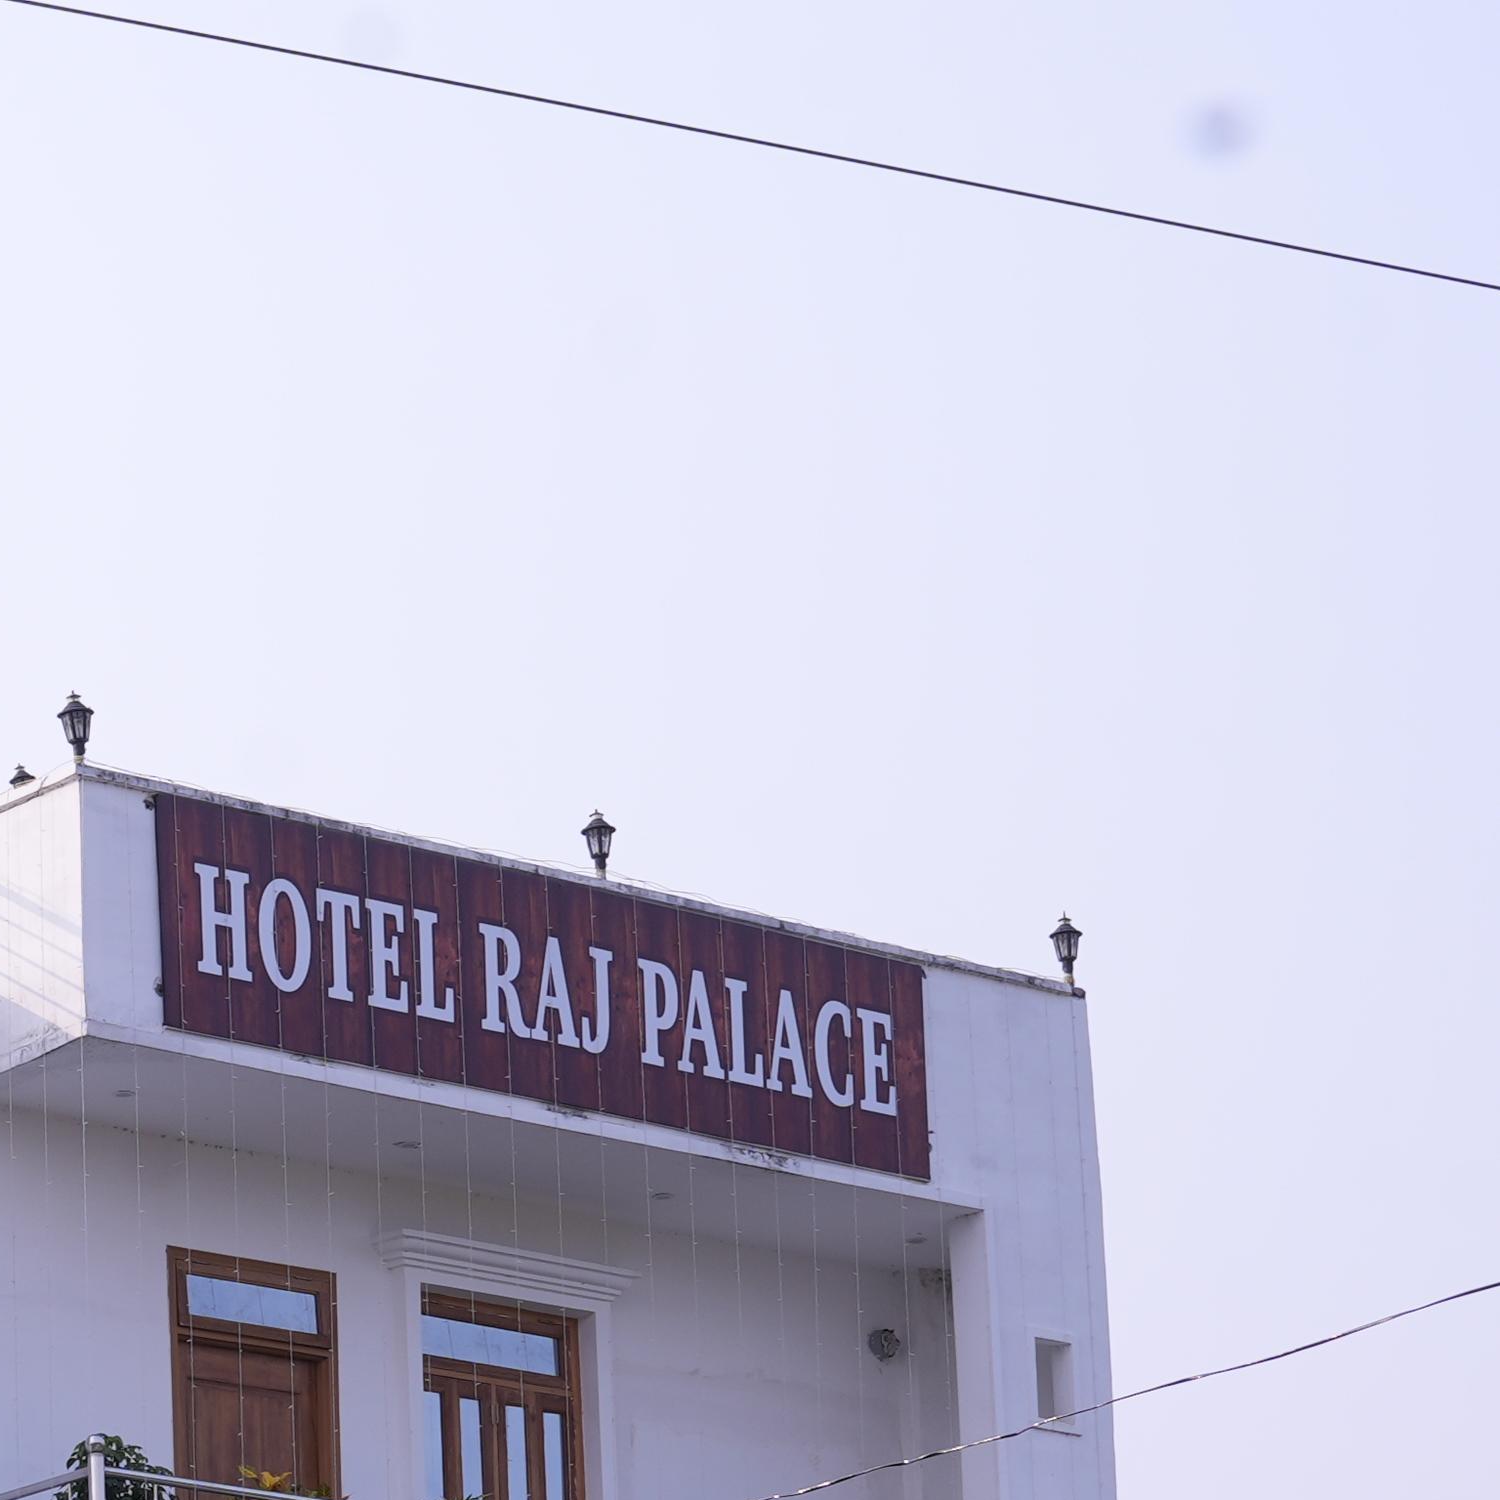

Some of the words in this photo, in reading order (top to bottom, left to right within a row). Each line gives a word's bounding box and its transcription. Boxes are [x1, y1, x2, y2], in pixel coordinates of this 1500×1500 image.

[194, 862, 455, 1024] HOTEL
[479, 922, 613, 1054] RAJ
[637, 958, 898, 1117] PALACE
